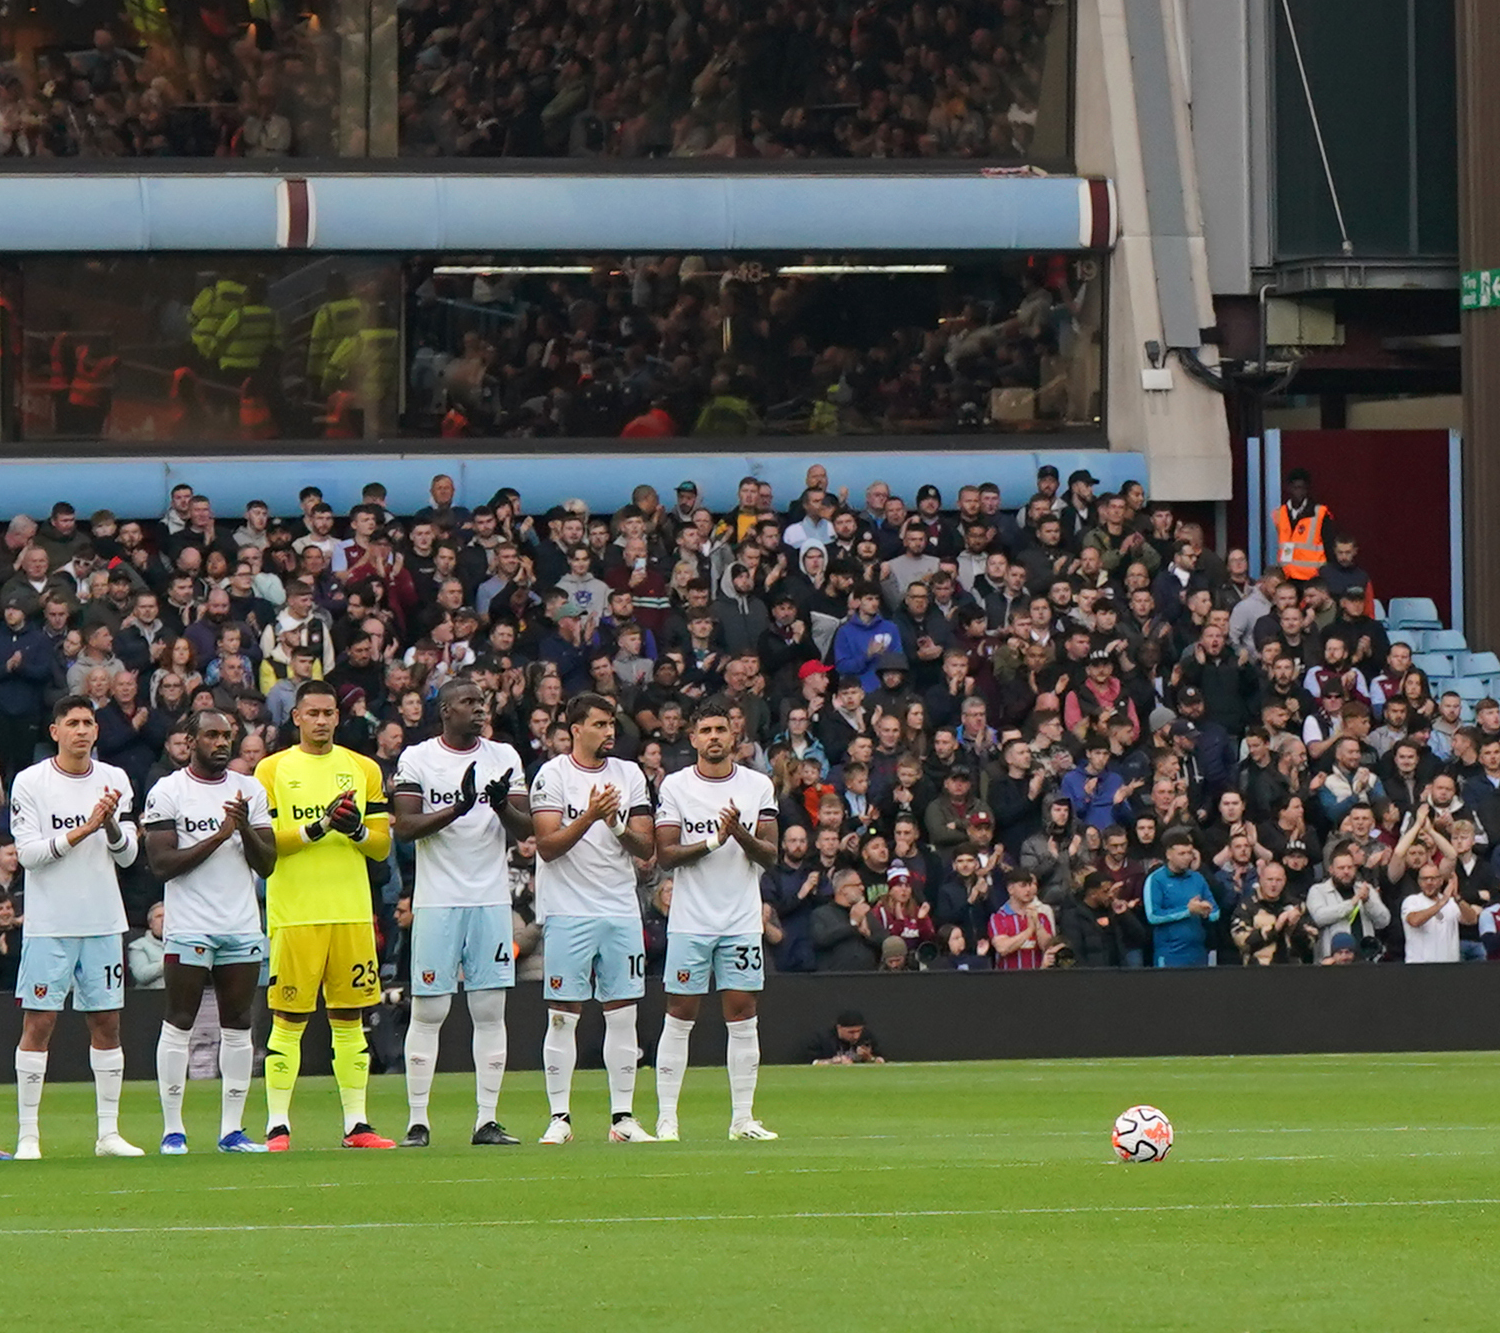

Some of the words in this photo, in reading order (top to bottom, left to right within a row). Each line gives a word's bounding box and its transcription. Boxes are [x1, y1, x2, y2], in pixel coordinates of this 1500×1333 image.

[1072, 259, 1098, 283] 19
[430, 789, 489, 805] beta
[51, 814, 91, 830] bet
[292, 805, 328, 821] bet
[567, 804, 628, 821] bey
[184, 817, 222, 833] bet
[683, 818, 753, 835] betwy
[494, 942, 510, 967] 4
[735, 946, 763, 971] 33
[104, 963, 123, 990] 19
[351, 960, 378, 988] 23
[627, 954, 645, 979] 10
